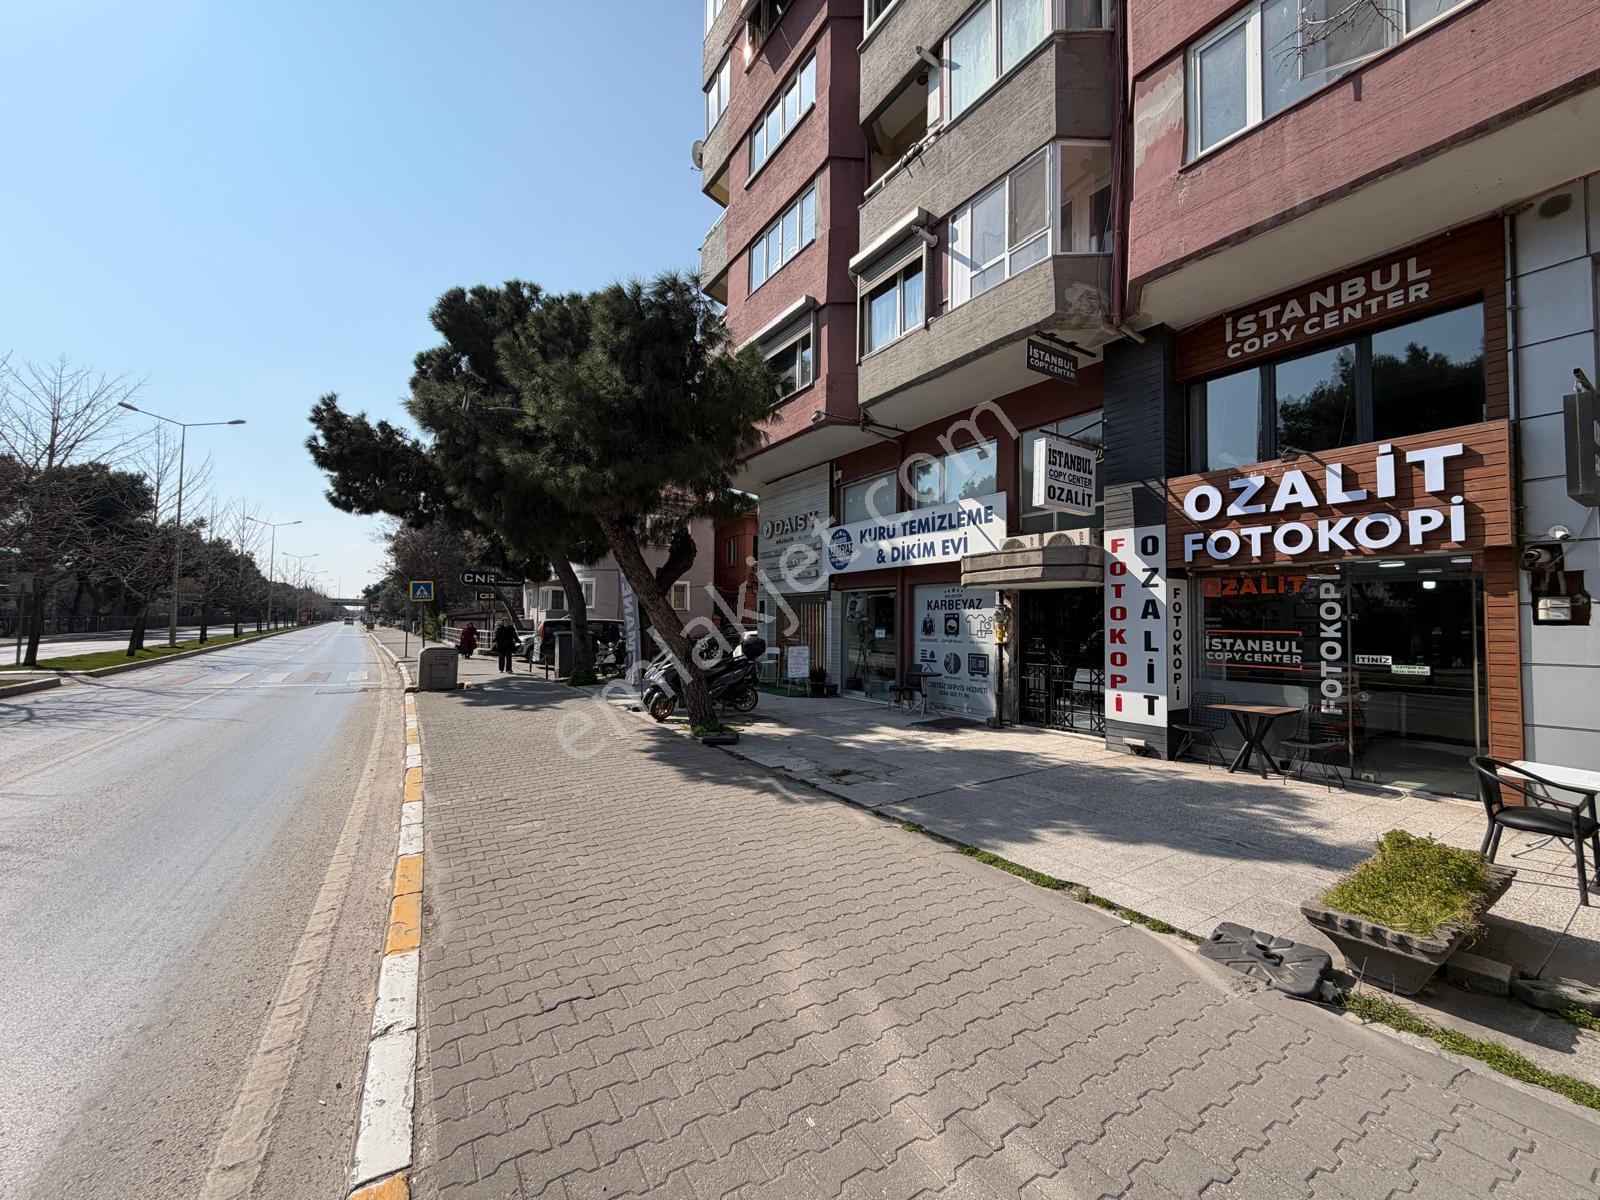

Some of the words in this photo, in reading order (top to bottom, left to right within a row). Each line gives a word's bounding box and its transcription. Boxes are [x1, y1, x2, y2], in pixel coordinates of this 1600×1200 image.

[1225, 257, 1431, 342] İSTANBUL
[1227, 325, 1297, 358] COPY
[1303, 282, 1429, 335] CENTER
[1029, 345, 1075, 372] İSTANBUL
[1030, 358, 1049, 370] COPY
[1049, 365, 1075, 379] CENTER
[1048, 444, 1093, 475] İSTANBUL
[1048, 469, 1067, 481] COPY
[1067, 474, 1092, 487] CENTER
[1183, 443, 1463, 521] OZALİT
[1047, 485, 1093, 508] OZALİT
[859, 524, 896, 543] KURU
[901, 506, 994, 536] TEMİZLEME
[1184, 495, 1466, 563] FOTOKOPİ
[876, 549, 886, 564] &
[891, 538, 936, 562] DİKİM
[941, 532, 968, 556] EVİ
[926, 598, 983, 611] KARBEYAZ
[1109, 537, 1128, 712] FOTOKOPİ
[1140, 535, 1160, 715] OZALİT
[1173, 588, 1182, 701] FOTOKOPİ
[1205, 636, 1303, 653] İSTANBUL
[1206, 651, 1242, 661] COPY
[1244, 653, 1302, 664] CENTER
